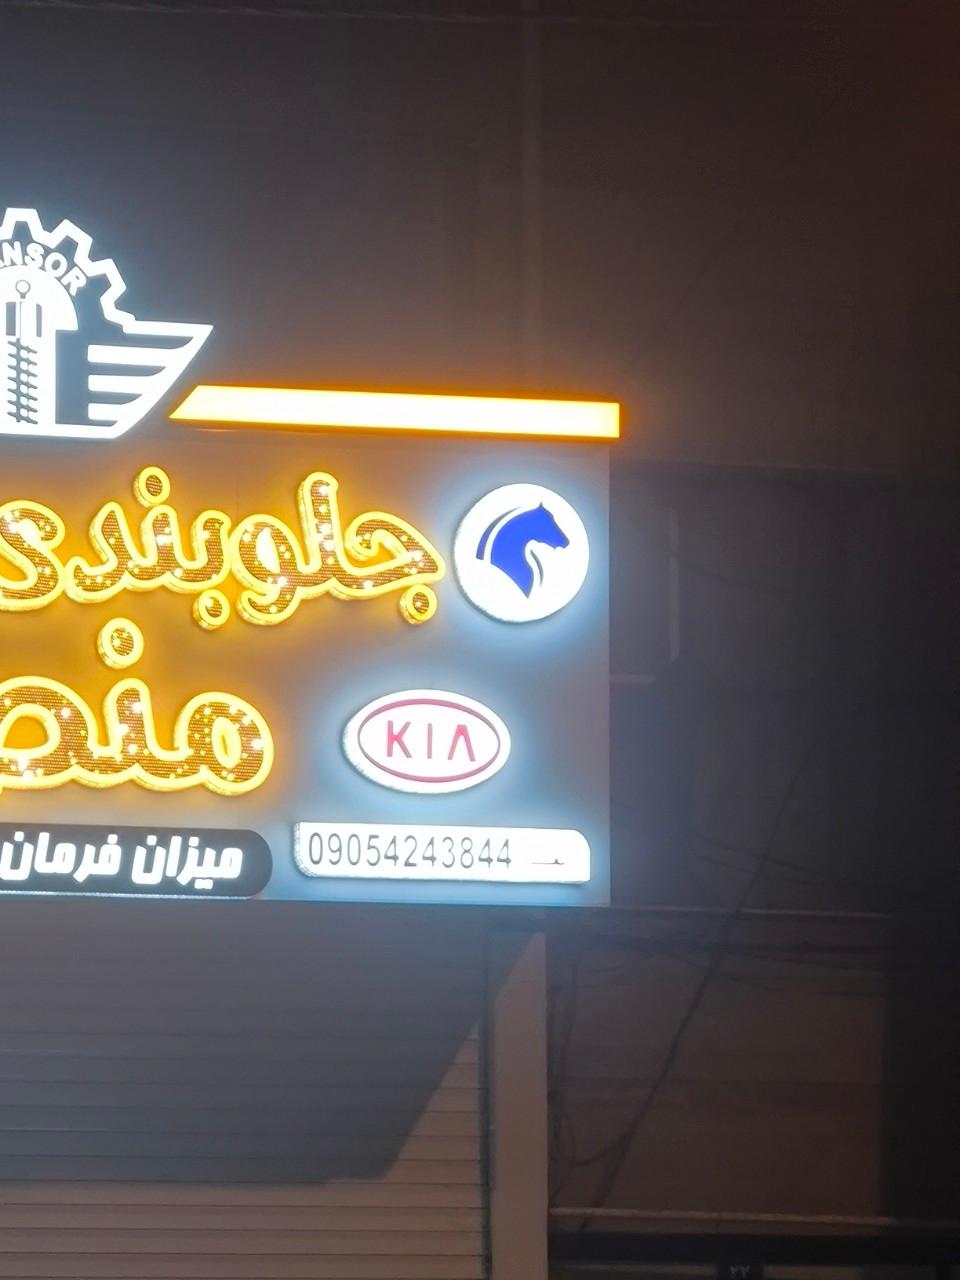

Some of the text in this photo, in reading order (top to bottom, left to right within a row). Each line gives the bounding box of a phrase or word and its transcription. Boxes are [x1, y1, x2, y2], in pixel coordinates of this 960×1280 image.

[386, 719, 476, 762] KIA
[131, 833, 243, 890] میزان
[308, 830, 512, 870] 09054243844
